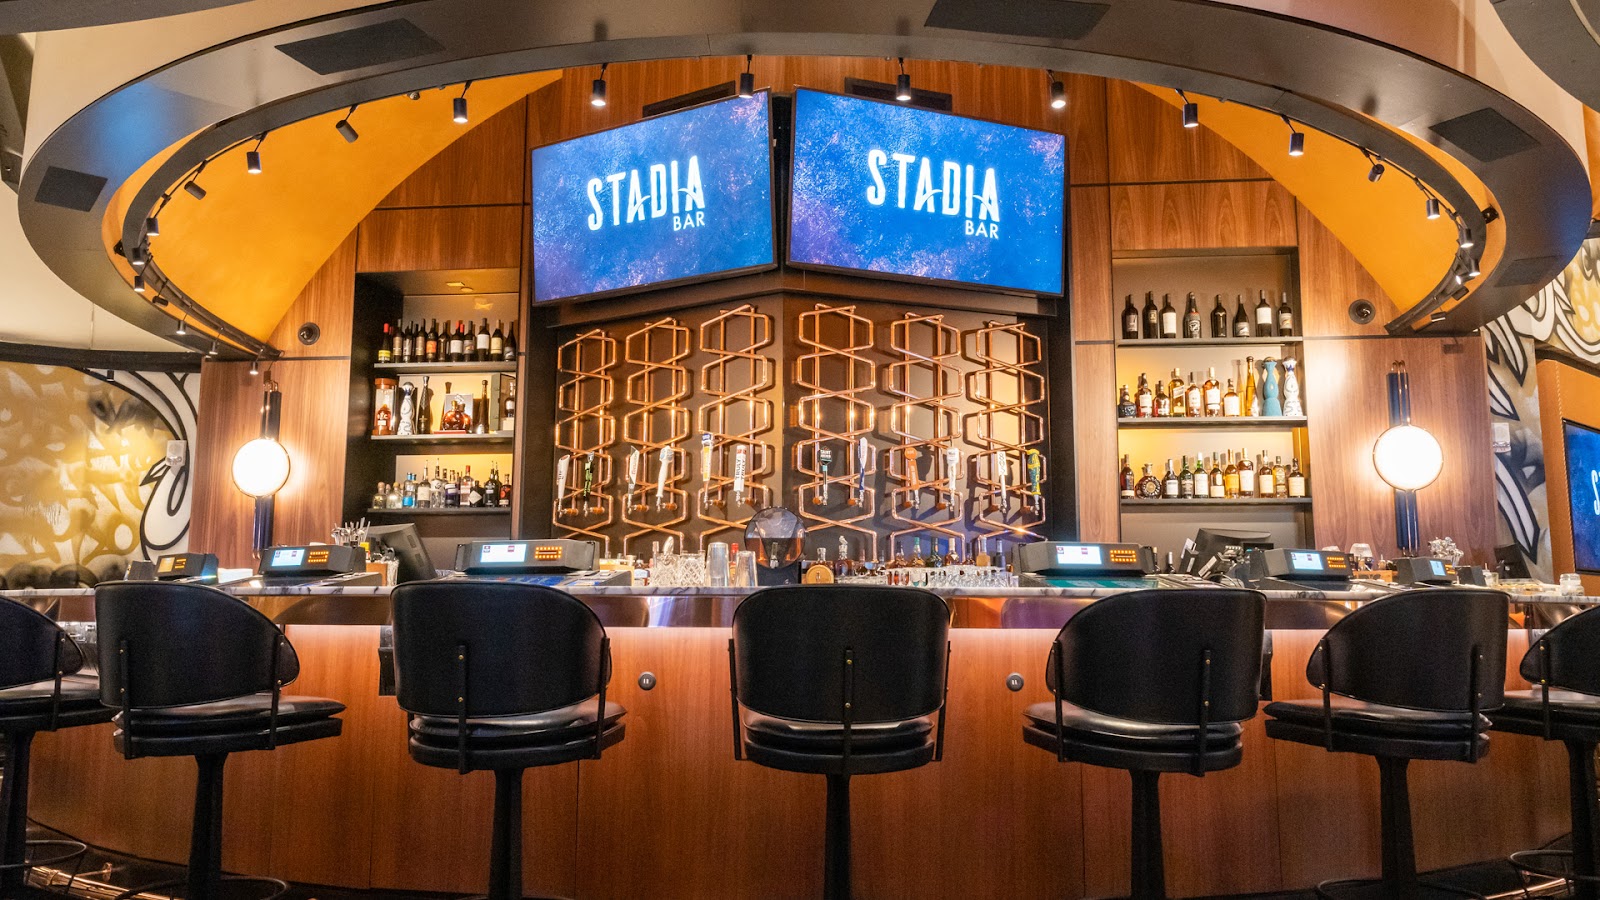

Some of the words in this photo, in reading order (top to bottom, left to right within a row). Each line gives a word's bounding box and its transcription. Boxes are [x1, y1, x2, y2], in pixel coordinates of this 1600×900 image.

[587, 155, 705, 231] STADIA
[867, 149, 1000, 222] STADIA
[673, 211, 705, 231] BAR
[965, 220, 999, 239] BAR
[1591, 469, 1600, 516] S
